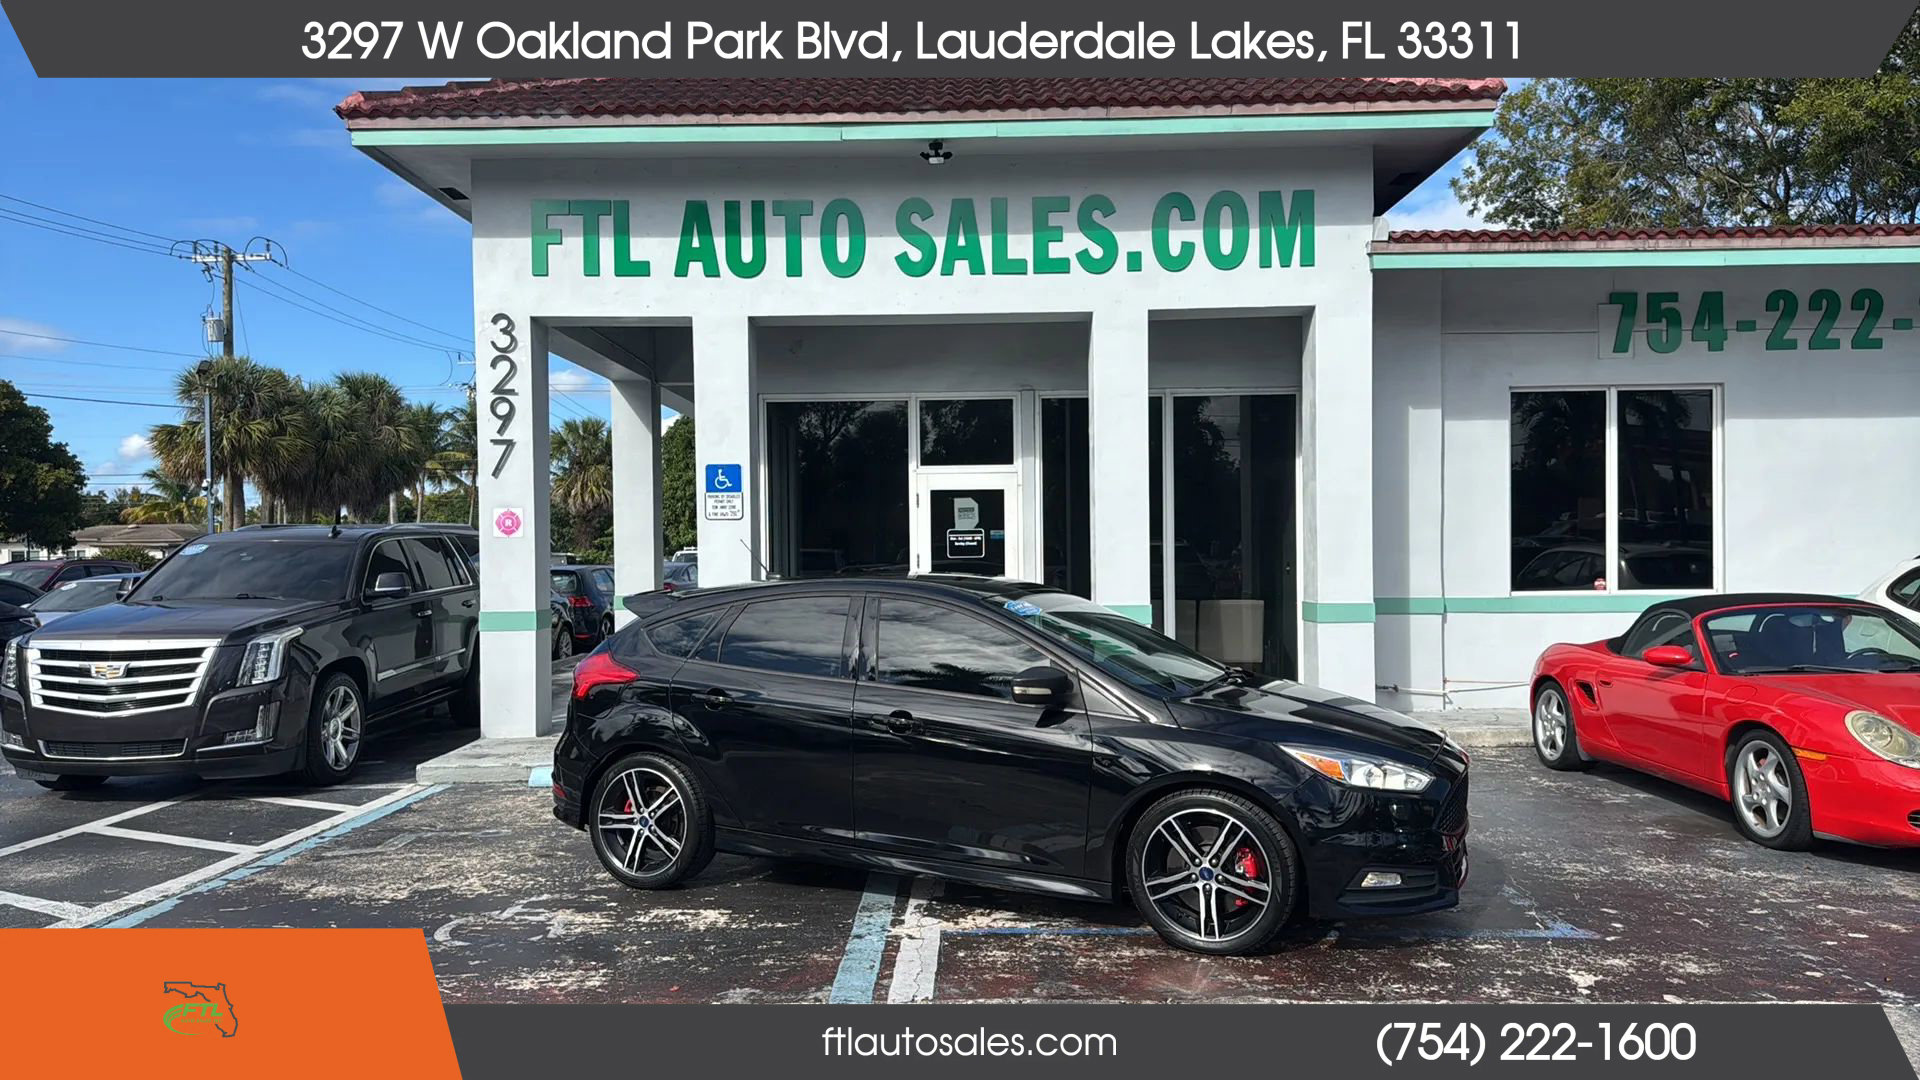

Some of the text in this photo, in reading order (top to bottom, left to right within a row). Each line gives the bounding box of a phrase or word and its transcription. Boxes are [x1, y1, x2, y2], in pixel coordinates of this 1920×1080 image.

[529, 190, 1317, 281] FTL AUTO SALES.COM
[1609, 290, 1920, 353] 754-222-
[490, 312, 519, 480] 3297
